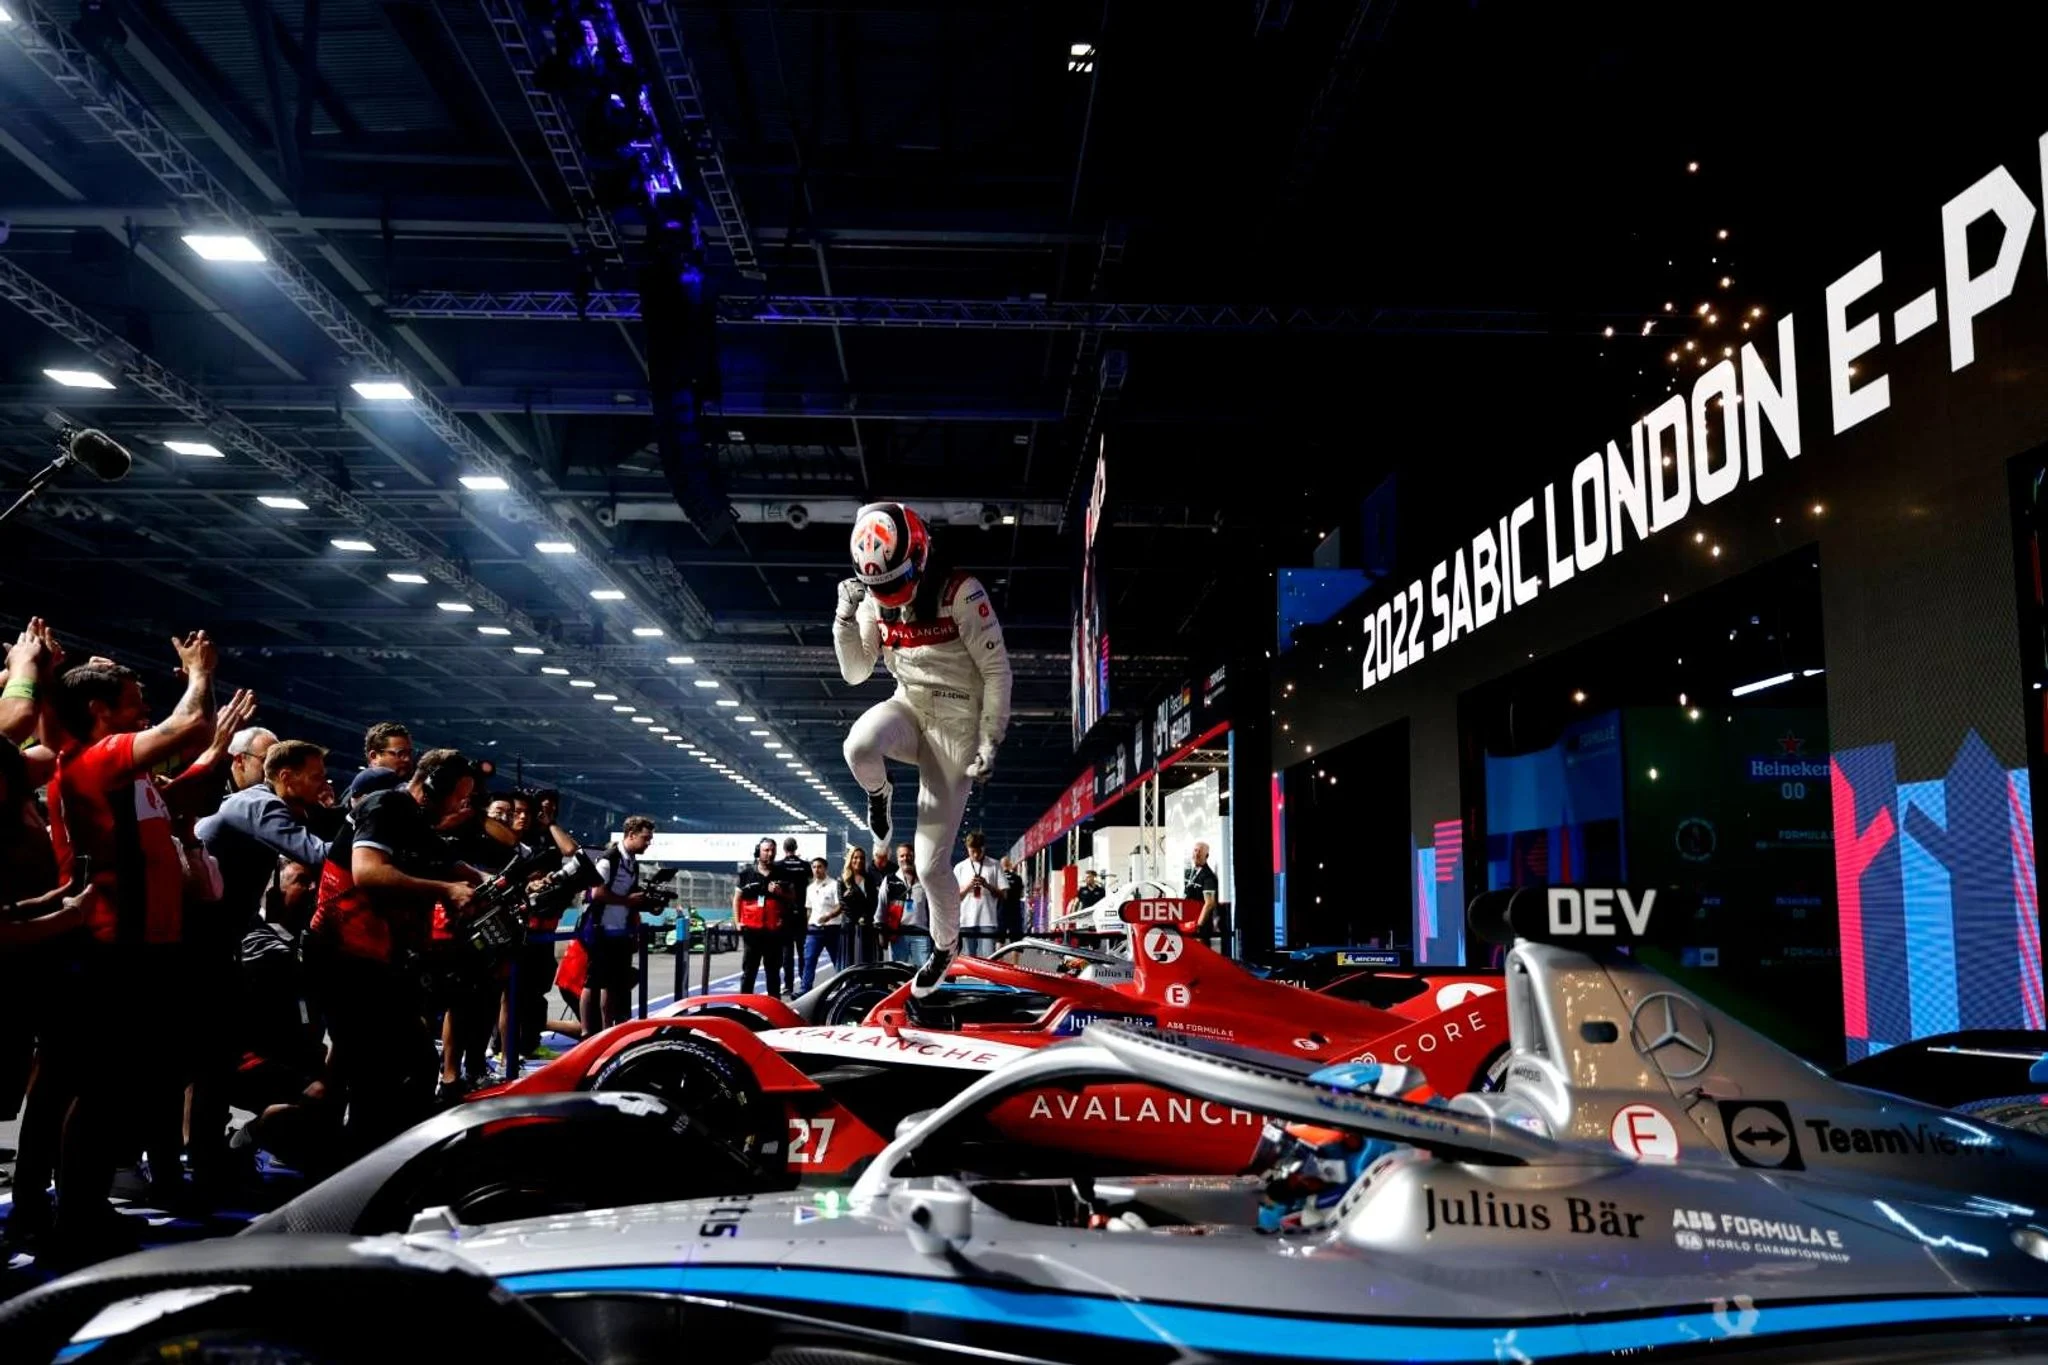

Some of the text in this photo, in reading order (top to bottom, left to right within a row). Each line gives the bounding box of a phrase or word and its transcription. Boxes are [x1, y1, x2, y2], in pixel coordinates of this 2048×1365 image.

[1362, 130, 2048, 690] 2022 SABIC LONDON E-P
[1140, 902, 1183, 921] DEN
[1548, 888, 1657, 936] DEV
[1172, 987, 1184, 1004] E
[1069, 1014, 1102, 1032] Juli
[1186, 1023, 1228, 1037] FORMULA
[1394, 1012, 1486, 1063] CORE
[787, 1118, 836, 1164] 27
[1805, 1119, 2017, 1158] TeamVie
[1425, 1187, 1645, 1240] Julius Bär
[1672, 1209, 1844, 1249] ABB FORMULA E
[1705, 1238, 1752, 1252] WORLD
[1754, 1243, 1851, 1264] CHAMPIONSHIP
